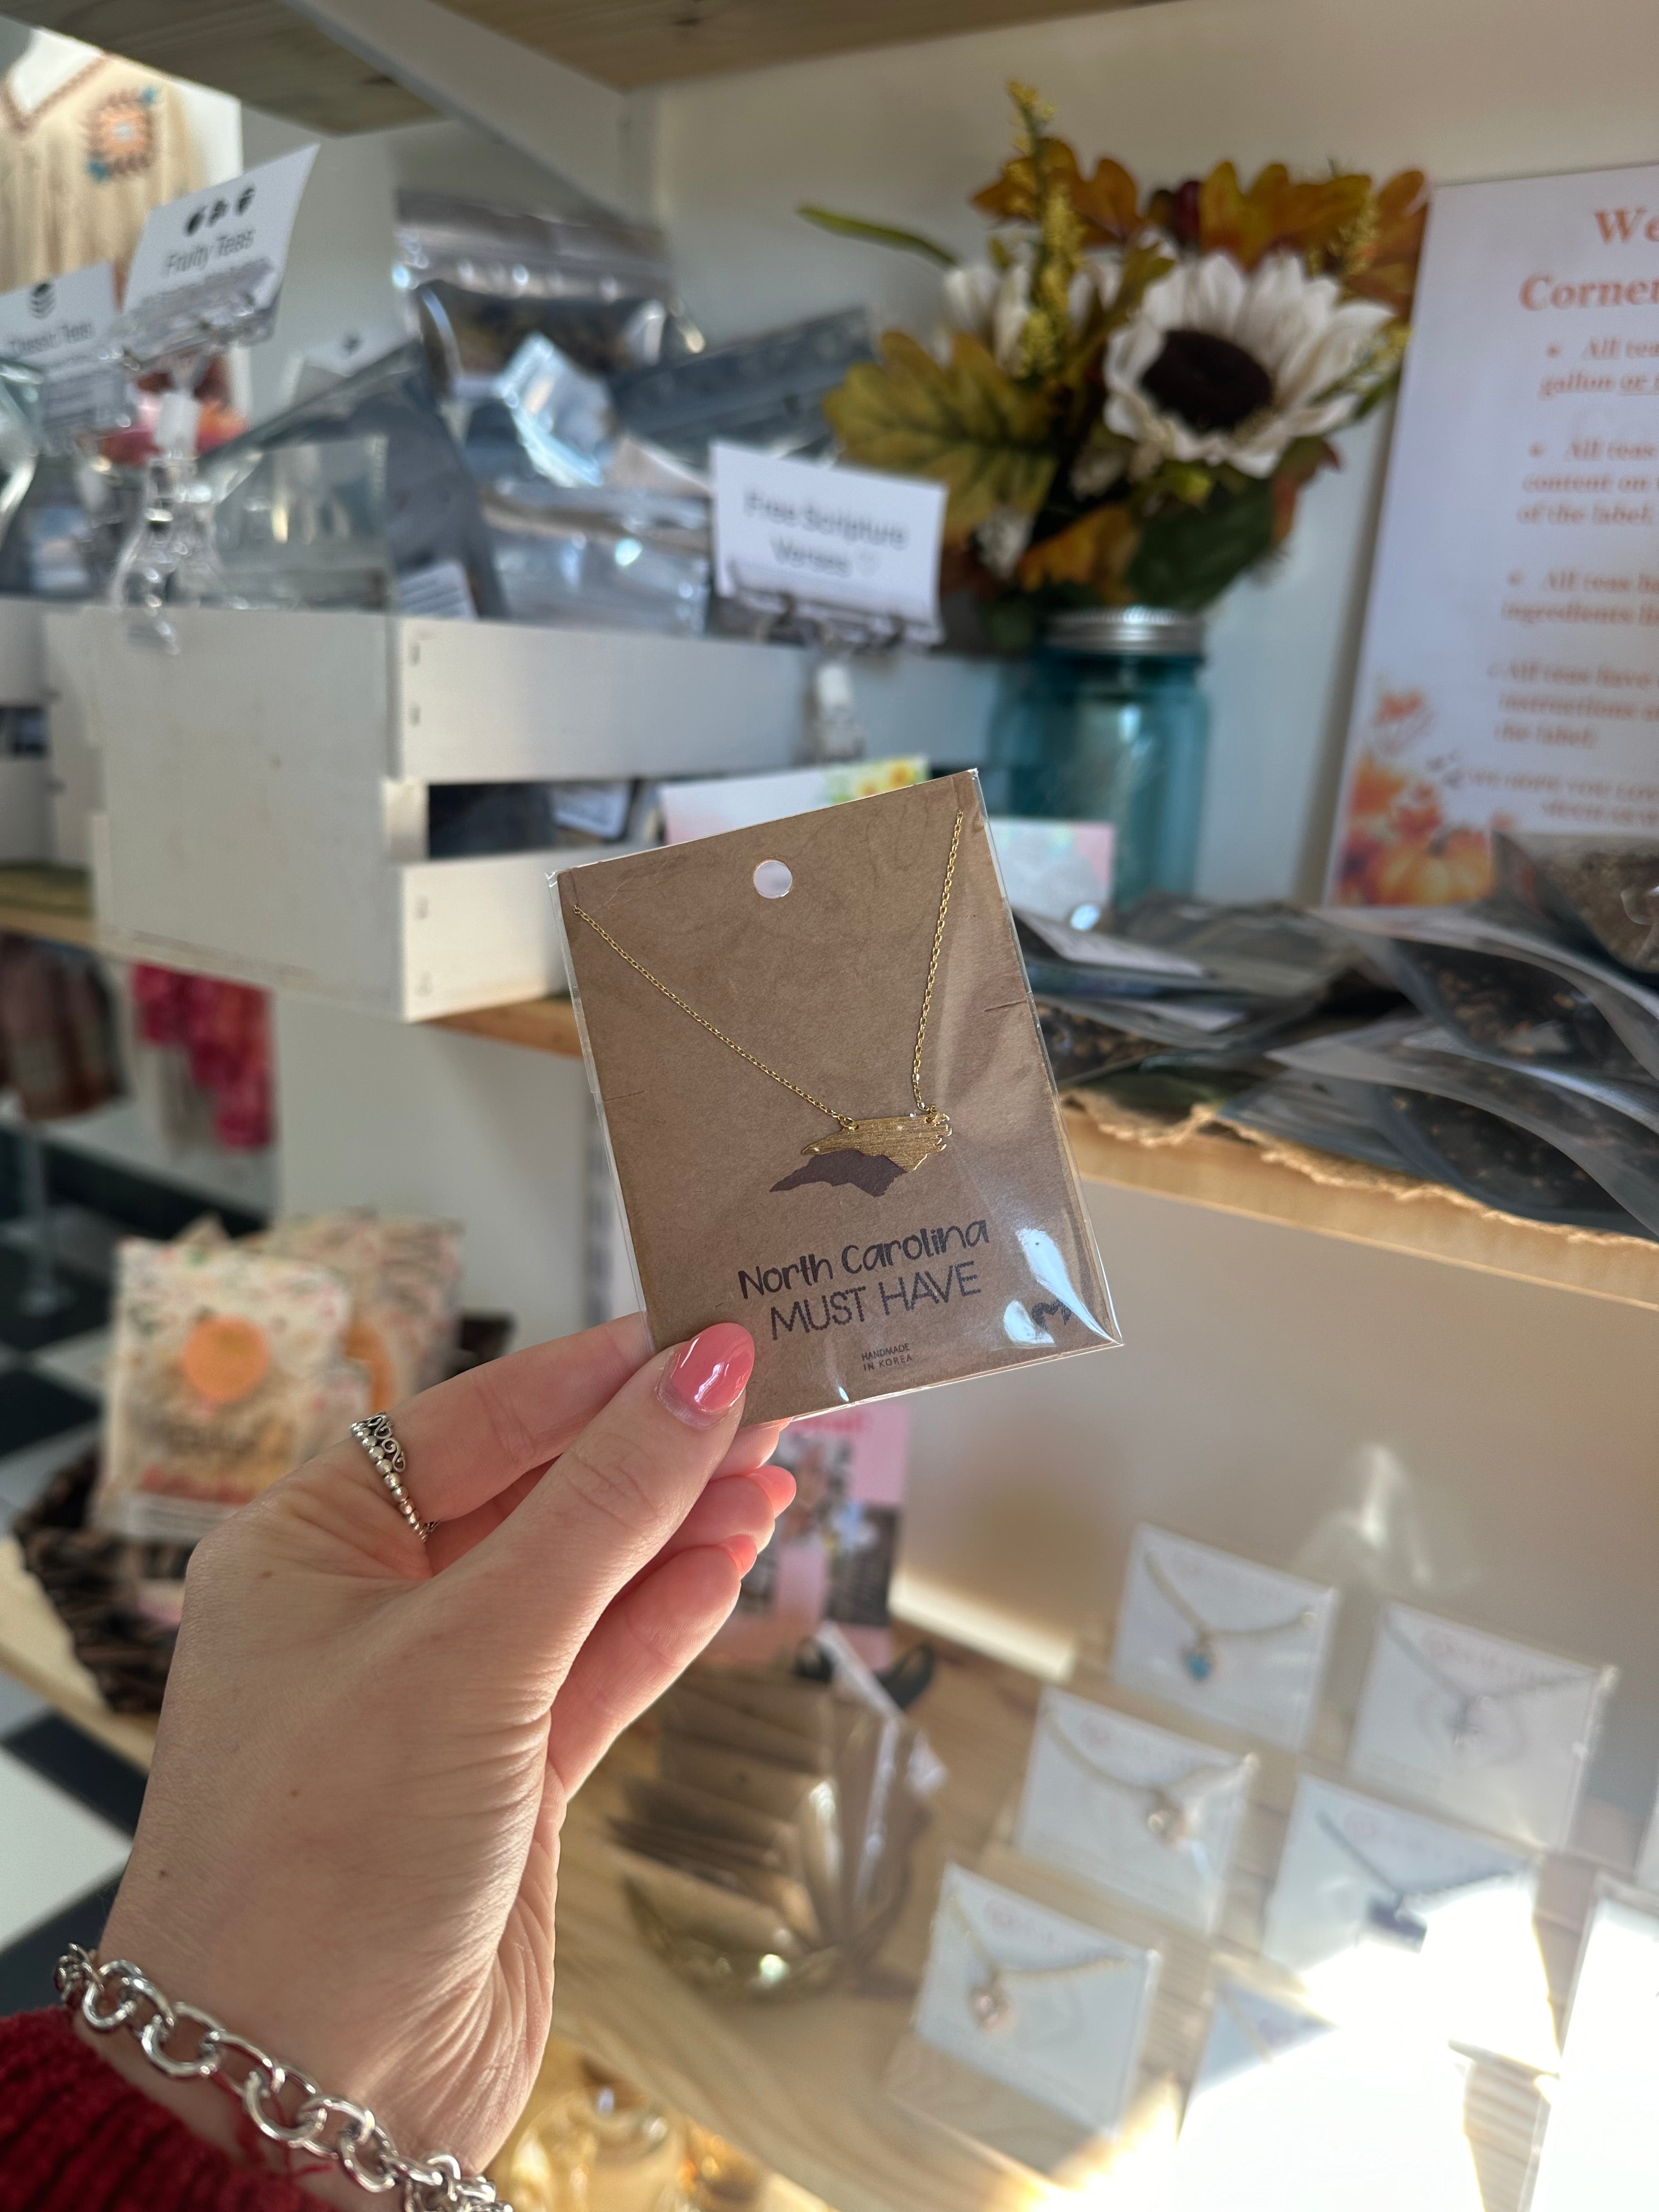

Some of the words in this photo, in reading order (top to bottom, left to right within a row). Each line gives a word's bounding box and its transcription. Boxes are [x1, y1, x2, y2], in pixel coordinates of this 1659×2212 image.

[165, 245, 212, 276] Fruity
[217, 228, 256, 256] Teas
[743, 488, 798, 528] Free
[800, 502, 911, 550] Scripture
[738, 1253, 833, 1299] North
[841, 1220, 989, 1274] Carolina
[771, 1285, 866, 1340] MUST
[878, 1261, 981, 1315] HAVE
[861, 1343, 911, 1361] HANDMADE
[864, 1362, 874, 1372] IN
[879, 1353, 913, 1368] KOREA
